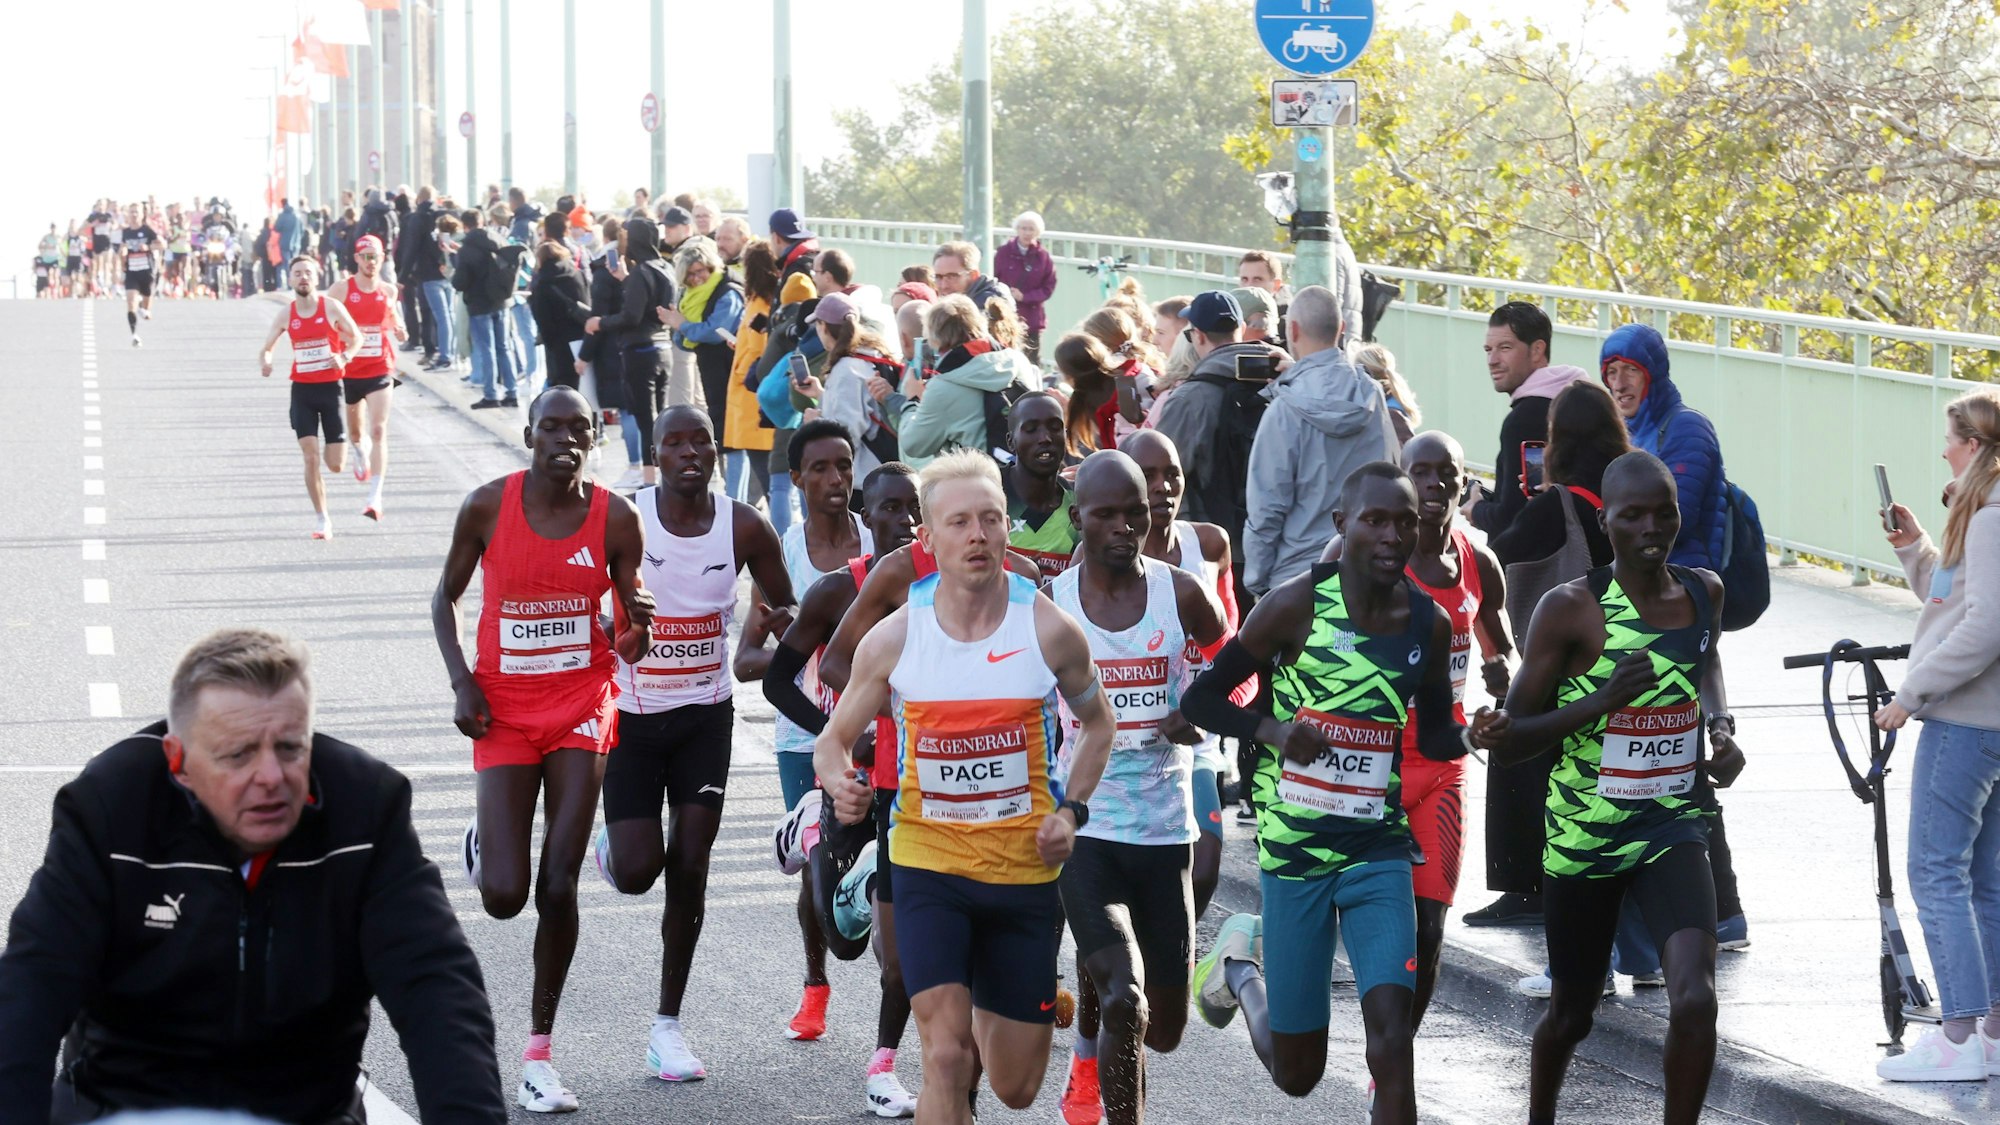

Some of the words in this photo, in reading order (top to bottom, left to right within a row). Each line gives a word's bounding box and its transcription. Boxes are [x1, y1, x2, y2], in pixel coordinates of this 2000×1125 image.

[302, 349, 323, 358] PACE
[519, 598, 587, 614] GENERALI
[512, 620, 575, 638] CHEBII
[660, 618, 720, 635] GENERALI
[542, 639, 547, 647] 2
[647, 641, 714, 658] KOSGEI
[1108, 690, 1166, 708] OECH
[1116, 712, 1122, 721] 3
[1635, 706, 1697, 730] GENERALI
[1321, 721, 1395, 746] GENERALI
[939, 729, 1023, 755] GENERALI
[1627, 737, 1685, 758] PACE
[940, 760, 1004, 782] PACE
[1650, 759, 1660, 768] 72
[1334, 774, 1344, 783] 71
[967, 783, 979, 792] 70
[1622, 788, 1654, 797] MARATHON
[1301, 795, 1336, 811] MARATHON
[1353, 806, 1372, 815] PUMA
[946, 811, 979, 821] MARATHON
[997, 807, 1018, 818] PUMA
